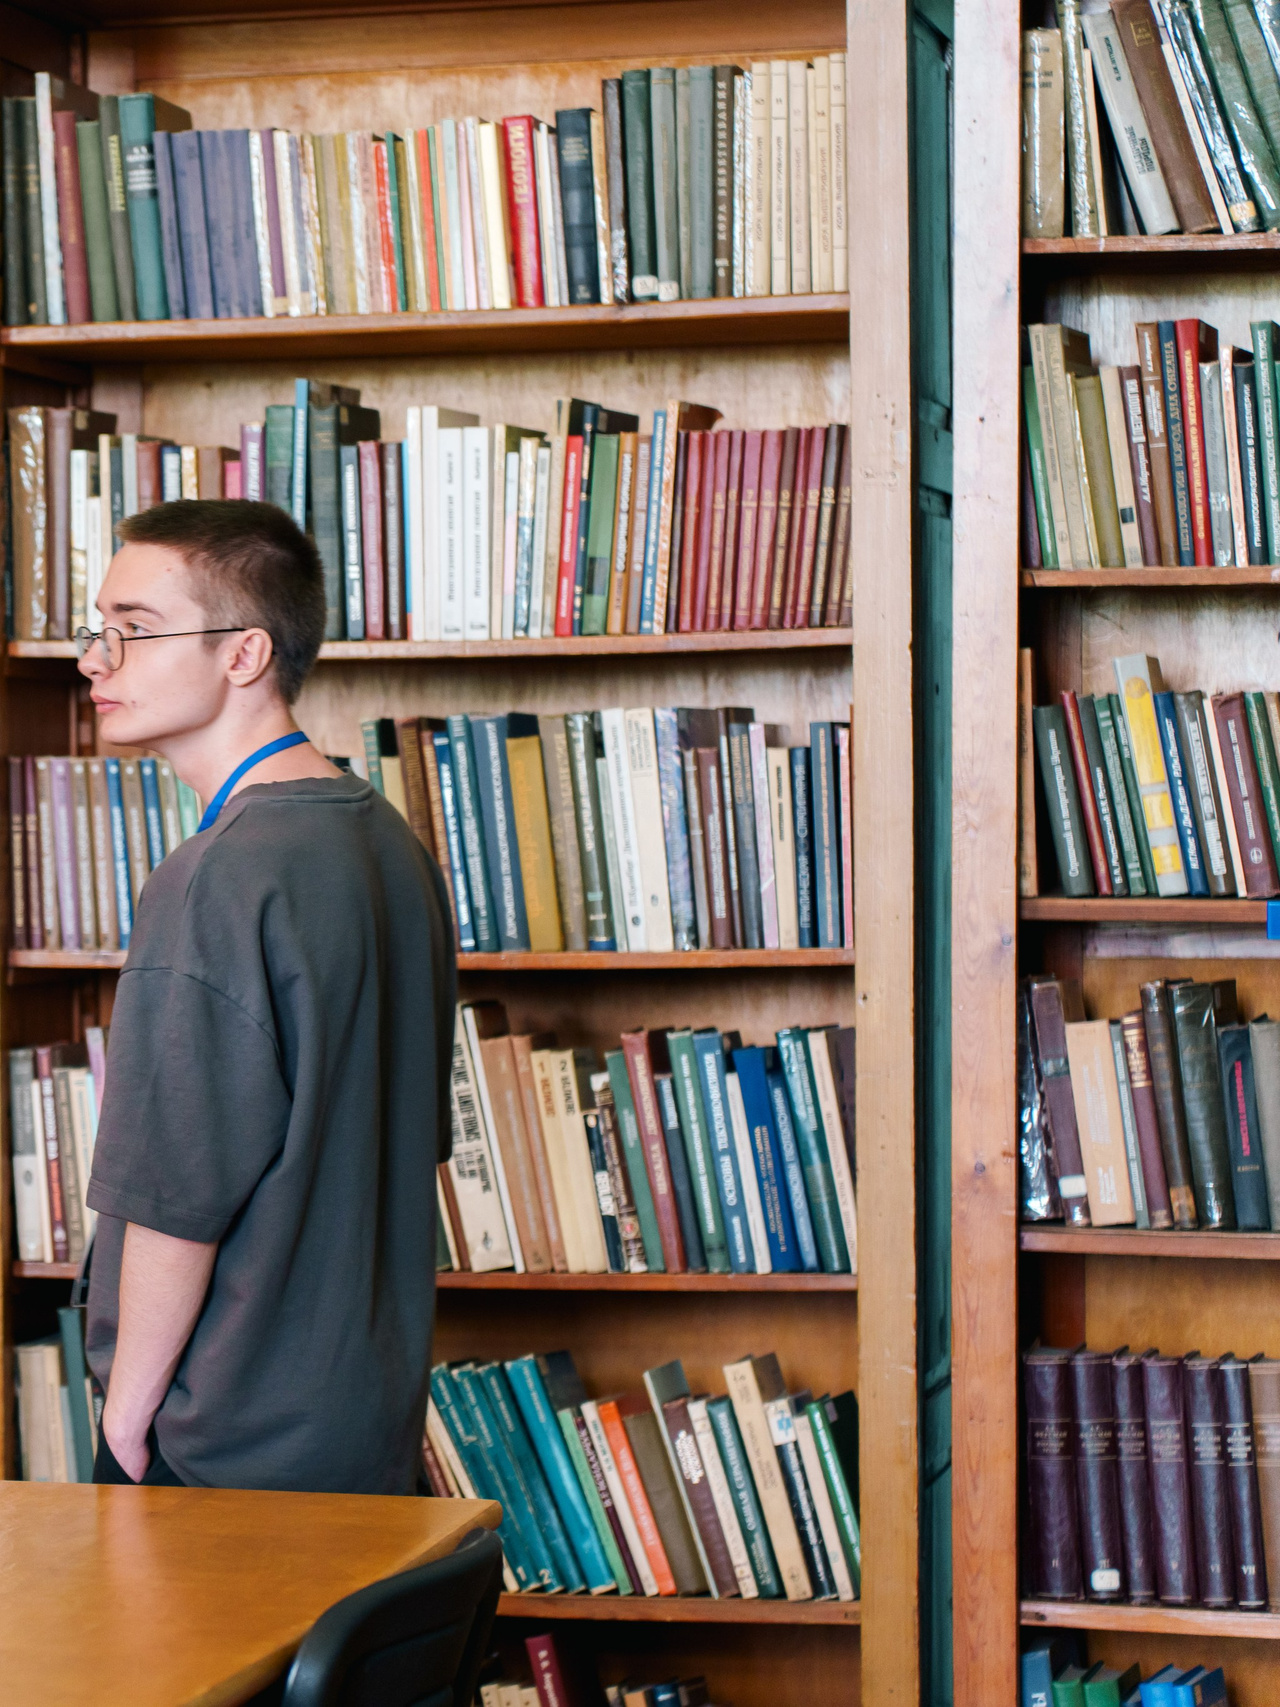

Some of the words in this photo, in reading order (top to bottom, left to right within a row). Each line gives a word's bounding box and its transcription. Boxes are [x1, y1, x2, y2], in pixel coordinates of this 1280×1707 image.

[716, 80, 726, 196] ВЫВЕТРИВАНИЯ
[716, 203, 727, 240] КОРА
[1164, 340, 1177, 391] ОКЕАНА
[1169, 393, 1180, 420] ДНА
[1171, 422, 1184, 466] ПОРОД
[1175, 469, 1190, 551] ПЕТРОЛОГИЯ
[634, 1053, 657, 1136] ДОКЕМБРИЯ
[704, 1052, 728, 1151] ТЕКТОНОФИЗИКИ
[650, 1142, 666, 1195] ШКАЛА
[720, 1155, 737, 1206] ОСНОВЫ
[785, 1162, 804, 1209] ОСНОВЫ
[717, 1410, 746, 1489] СТРАТИГРАФИЯ
[539, 1568, 552, 1585] 2
[1242, 1564, 1256, 1575] VII
